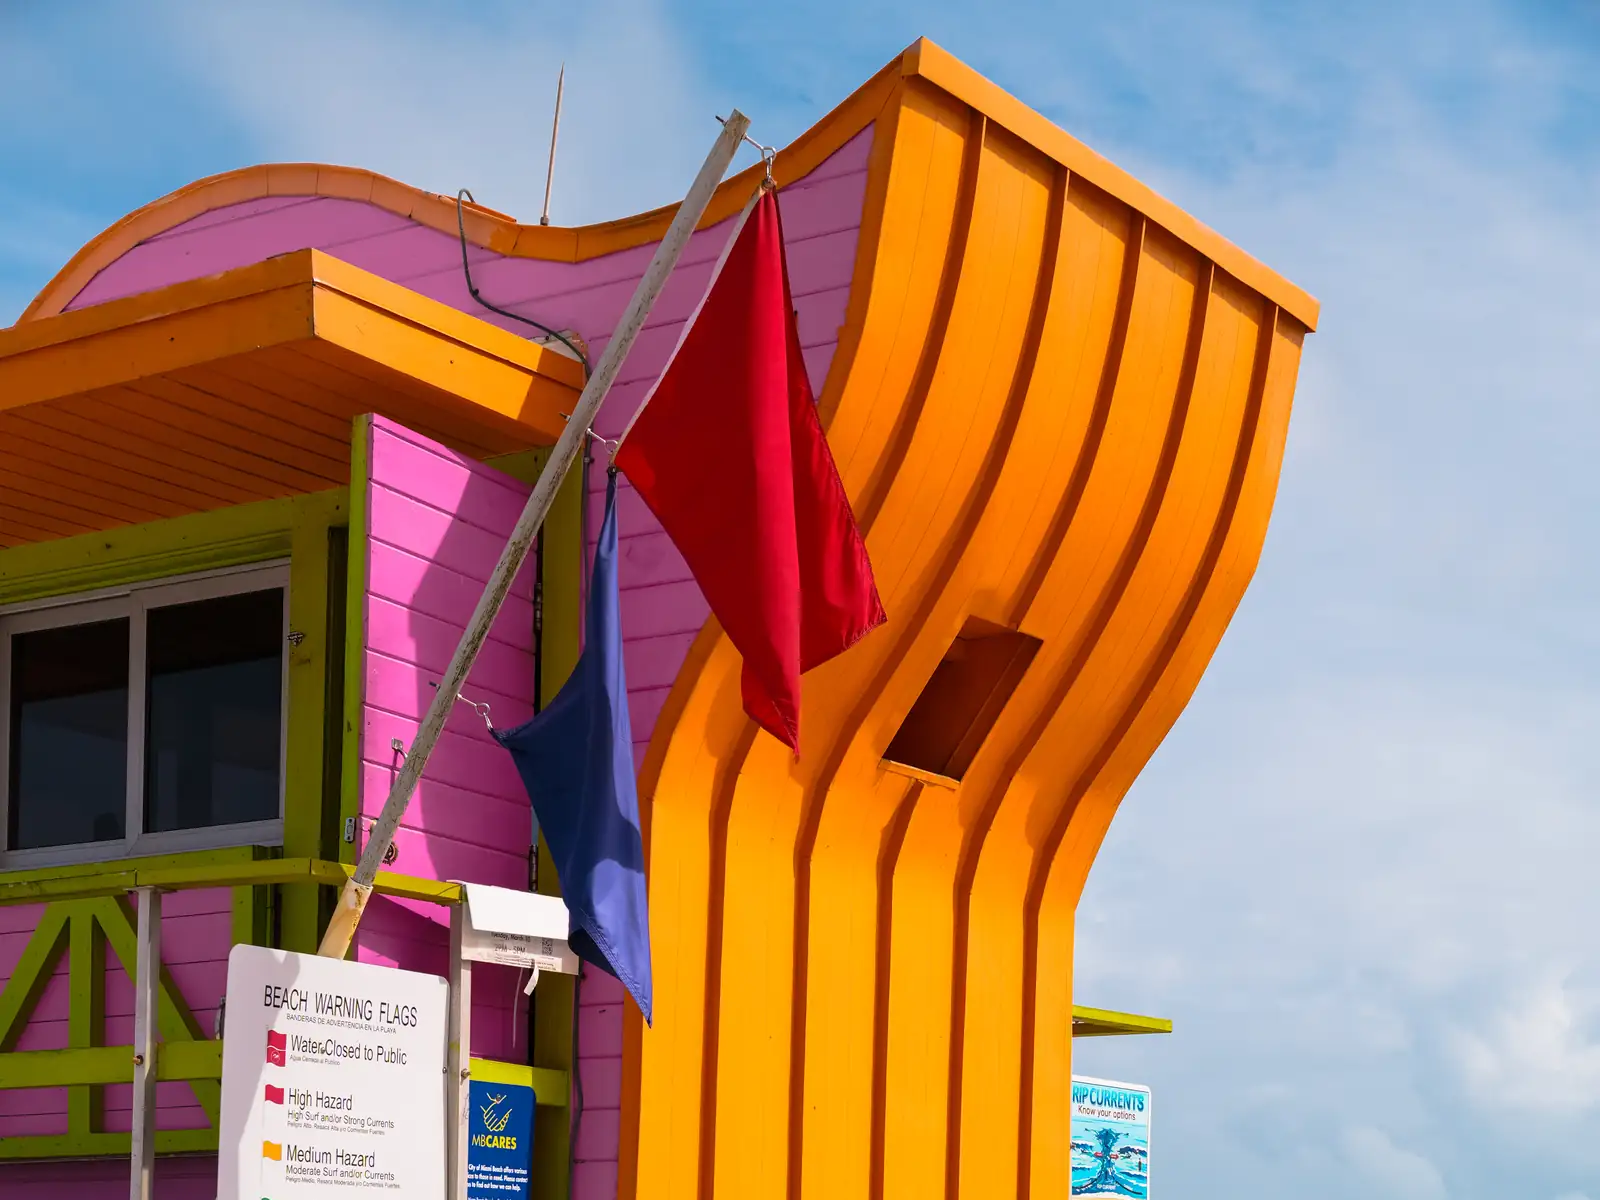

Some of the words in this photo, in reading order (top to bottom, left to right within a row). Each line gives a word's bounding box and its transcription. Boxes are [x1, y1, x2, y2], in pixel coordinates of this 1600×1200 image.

[264, 985, 308, 1011] BEACH
[316, 993, 372, 1020] WARNING
[380, 1002, 417, 1027] FLAGS
[287, 1013, 316, 1023] BANDERAS
[326, 1018, 363, 1030] ADVERTENCIA
[381, 1026, 396, 1034] PLAYA
[291, 1034, 322, 1054] Water
[325, 1039, 360, 1059] Closed
[364, 1045, 373, 1060] to
[377, 1045, 407, 1065] Public
[289, 1088, 312, 1110] High
[316, 1091, 352, 1110] Hazard
[1073, 1085, 1089, 1103] RIP
[1090, 1088, 1144, 1112] CURRENTS
[288, 1109, 303, 1121] High
[305, 1111, 319, 1121] Surf
[321, 1114, 342, 1123] and/or
[344, 1115, 364, 1128] Strong
[367, 1117, 394, 1128] Currents
[1078, 1105, 1096, 1115] Know
[1097, 1109, 1111, 1117] your
[1113, 1111, 1136, 1120] options
[287, 1144, 331, 1164] Medium
[336, 1148, 375, 1168] Hazard
[286, 1165, 321, 1176] Moderate
[323, 1167, 338, 1177] Surf
[340, 1169, 362, 1179] and/or
[365, 1170, 395, 1181] Currents
